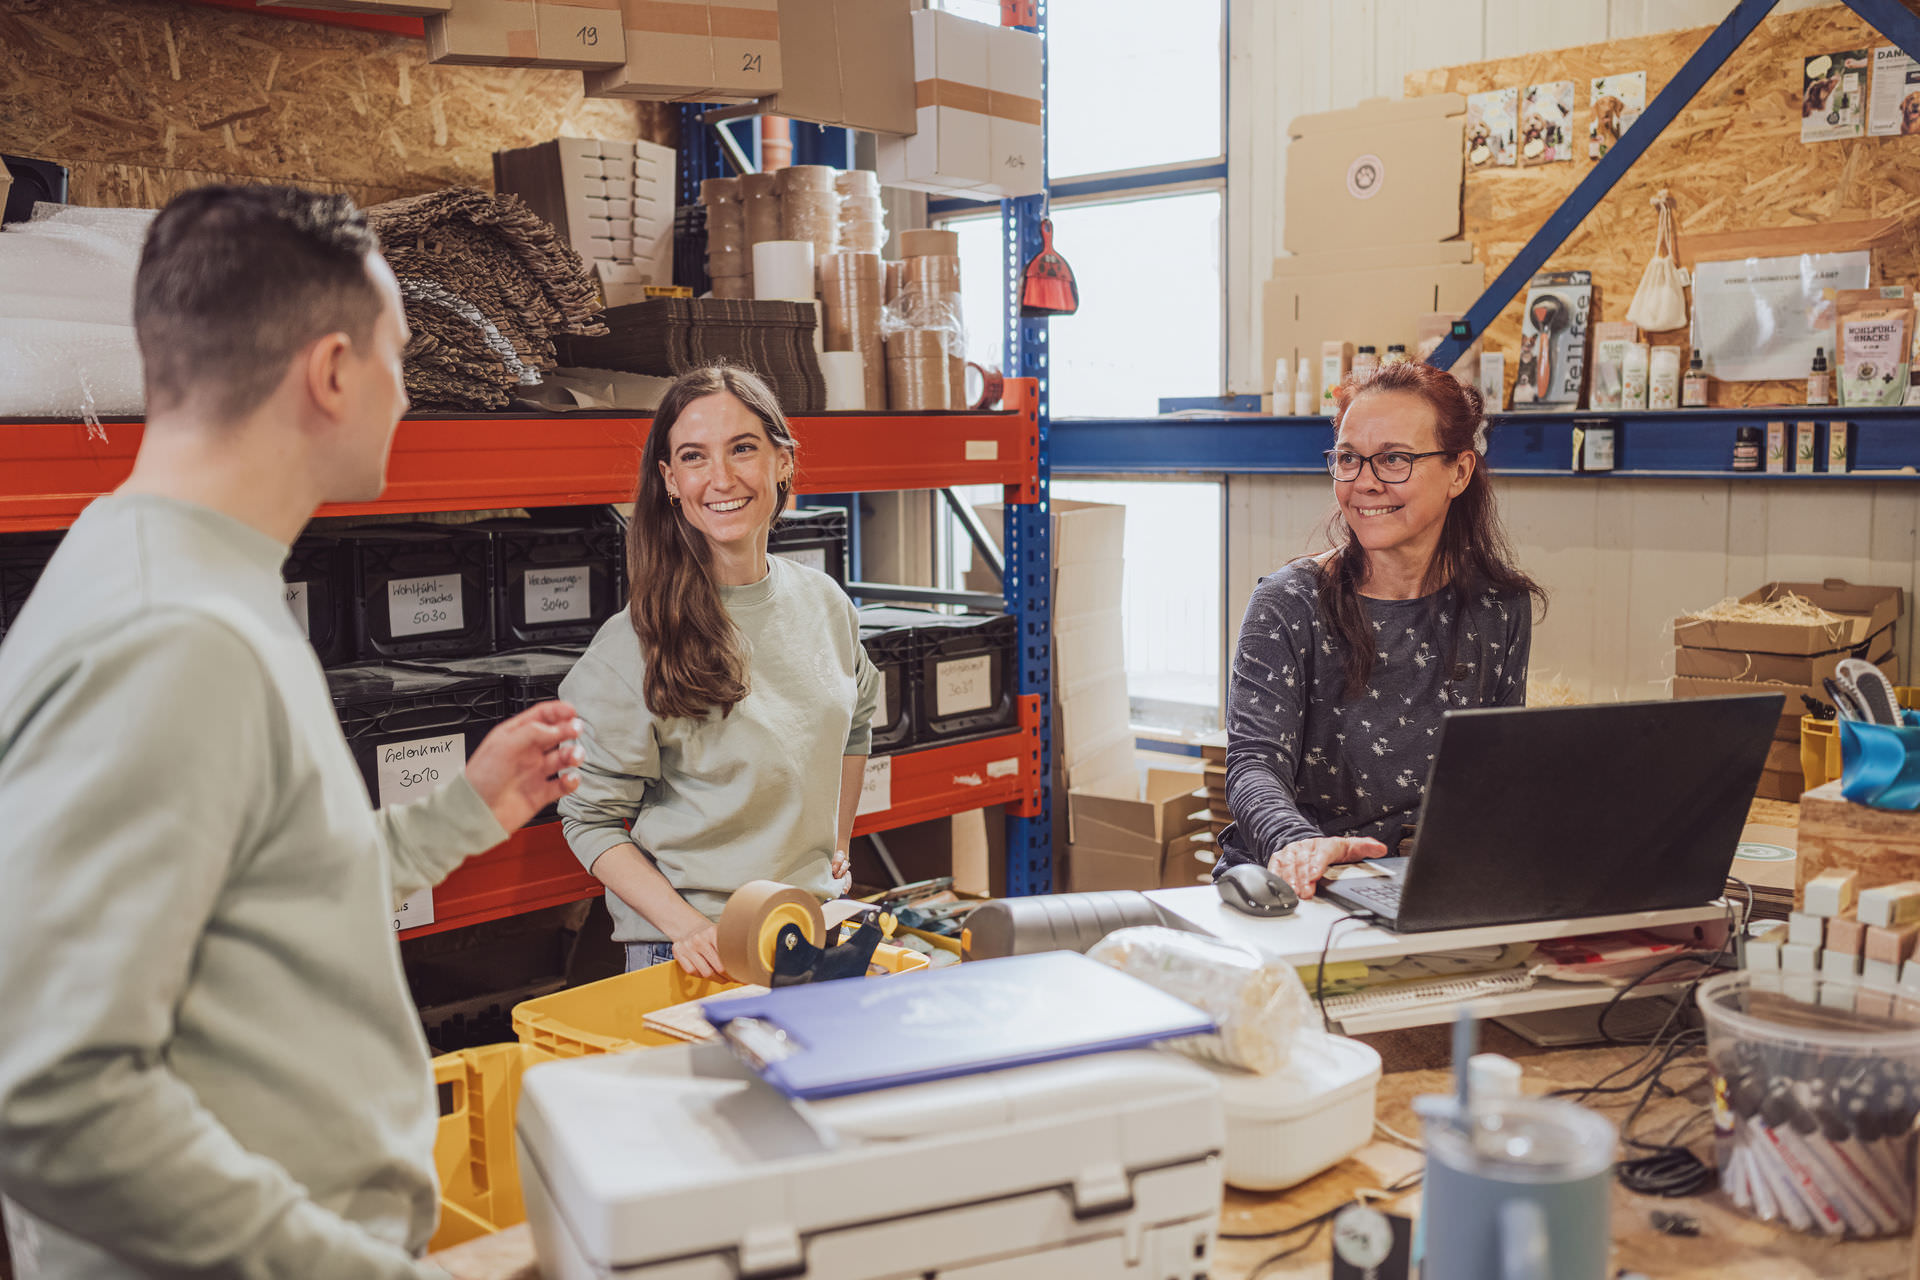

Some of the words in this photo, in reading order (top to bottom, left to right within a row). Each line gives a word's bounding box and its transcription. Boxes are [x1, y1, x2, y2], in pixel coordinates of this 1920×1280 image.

[576, 25, 599, 46] 19
[742, 53, 761, 73] 21
[1563, 295, 1590, 394] Fellfee
[418, 592, 453, 606] snacks
[541, 597, 569, 612] 3040
[412, 608, 447, 625] 5030
[399, 767, 439, 788] 3010
